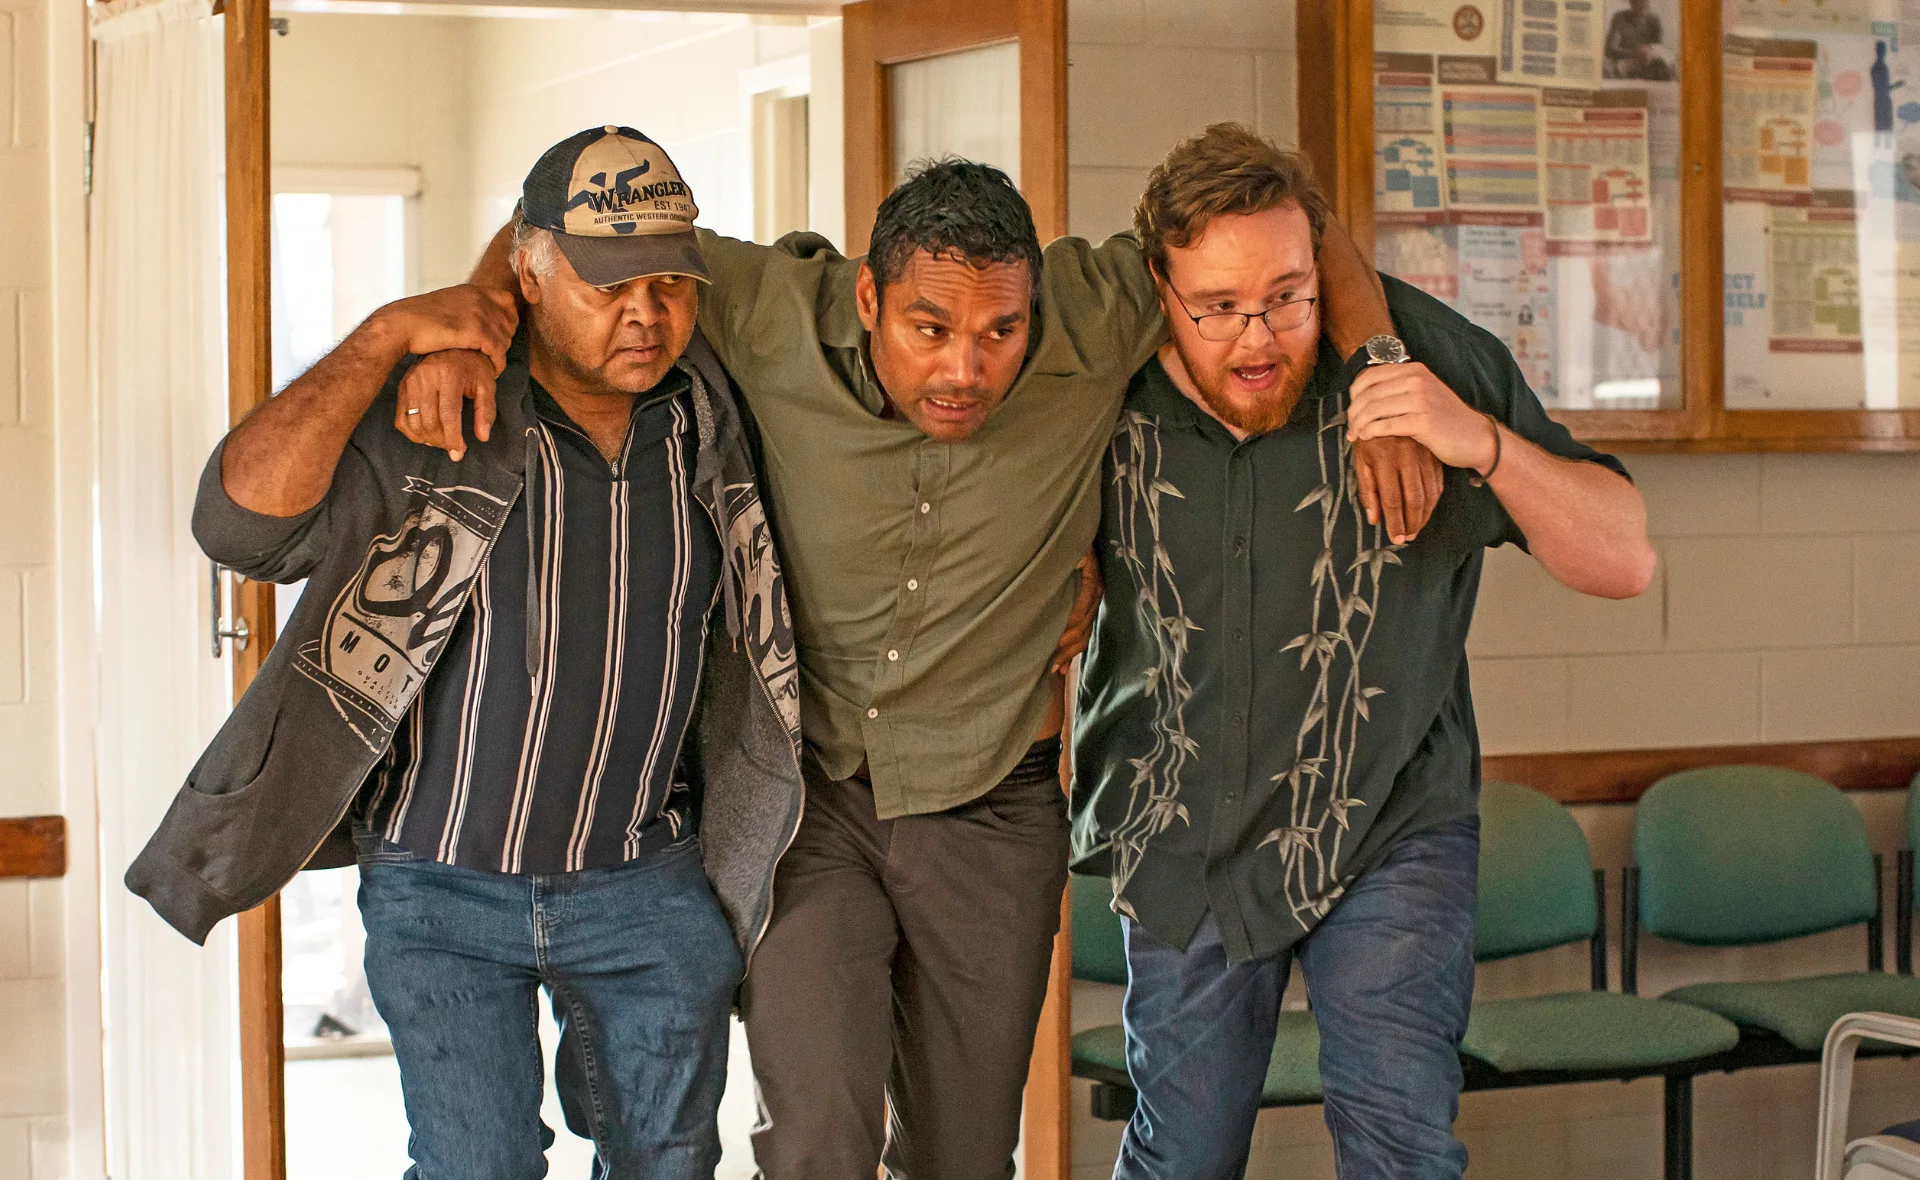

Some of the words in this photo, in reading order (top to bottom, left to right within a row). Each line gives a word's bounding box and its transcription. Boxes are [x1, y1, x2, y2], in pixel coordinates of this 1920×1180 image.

[589, 181, 687, 214] WRANGLER
[654, 200, 671, 210] EST
[674, 202, 690, 213] 1947
[594, 213, 635, 225] AUTHENTIC
[636, 213, 669, 221] WESTERN
